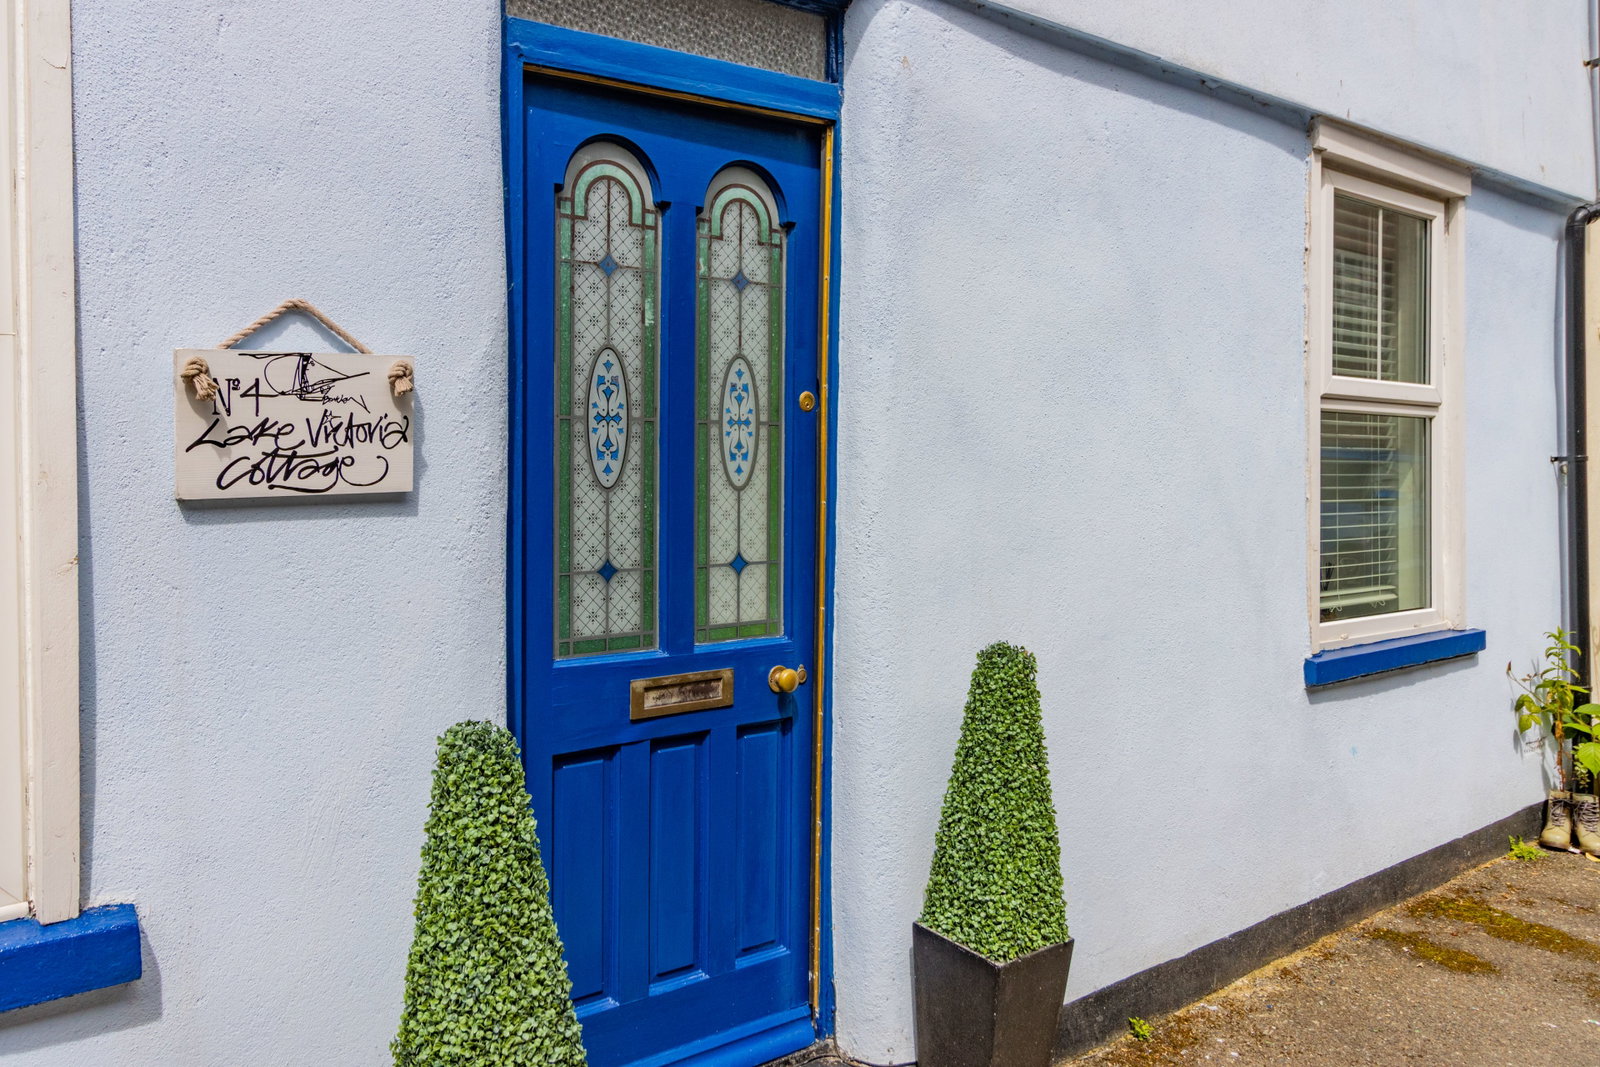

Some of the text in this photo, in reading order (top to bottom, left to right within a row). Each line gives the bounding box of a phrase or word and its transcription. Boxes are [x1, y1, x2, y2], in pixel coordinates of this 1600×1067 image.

[240, 377, 279, 417] 4
[186, 408, 409, 453] Lake Victoria
